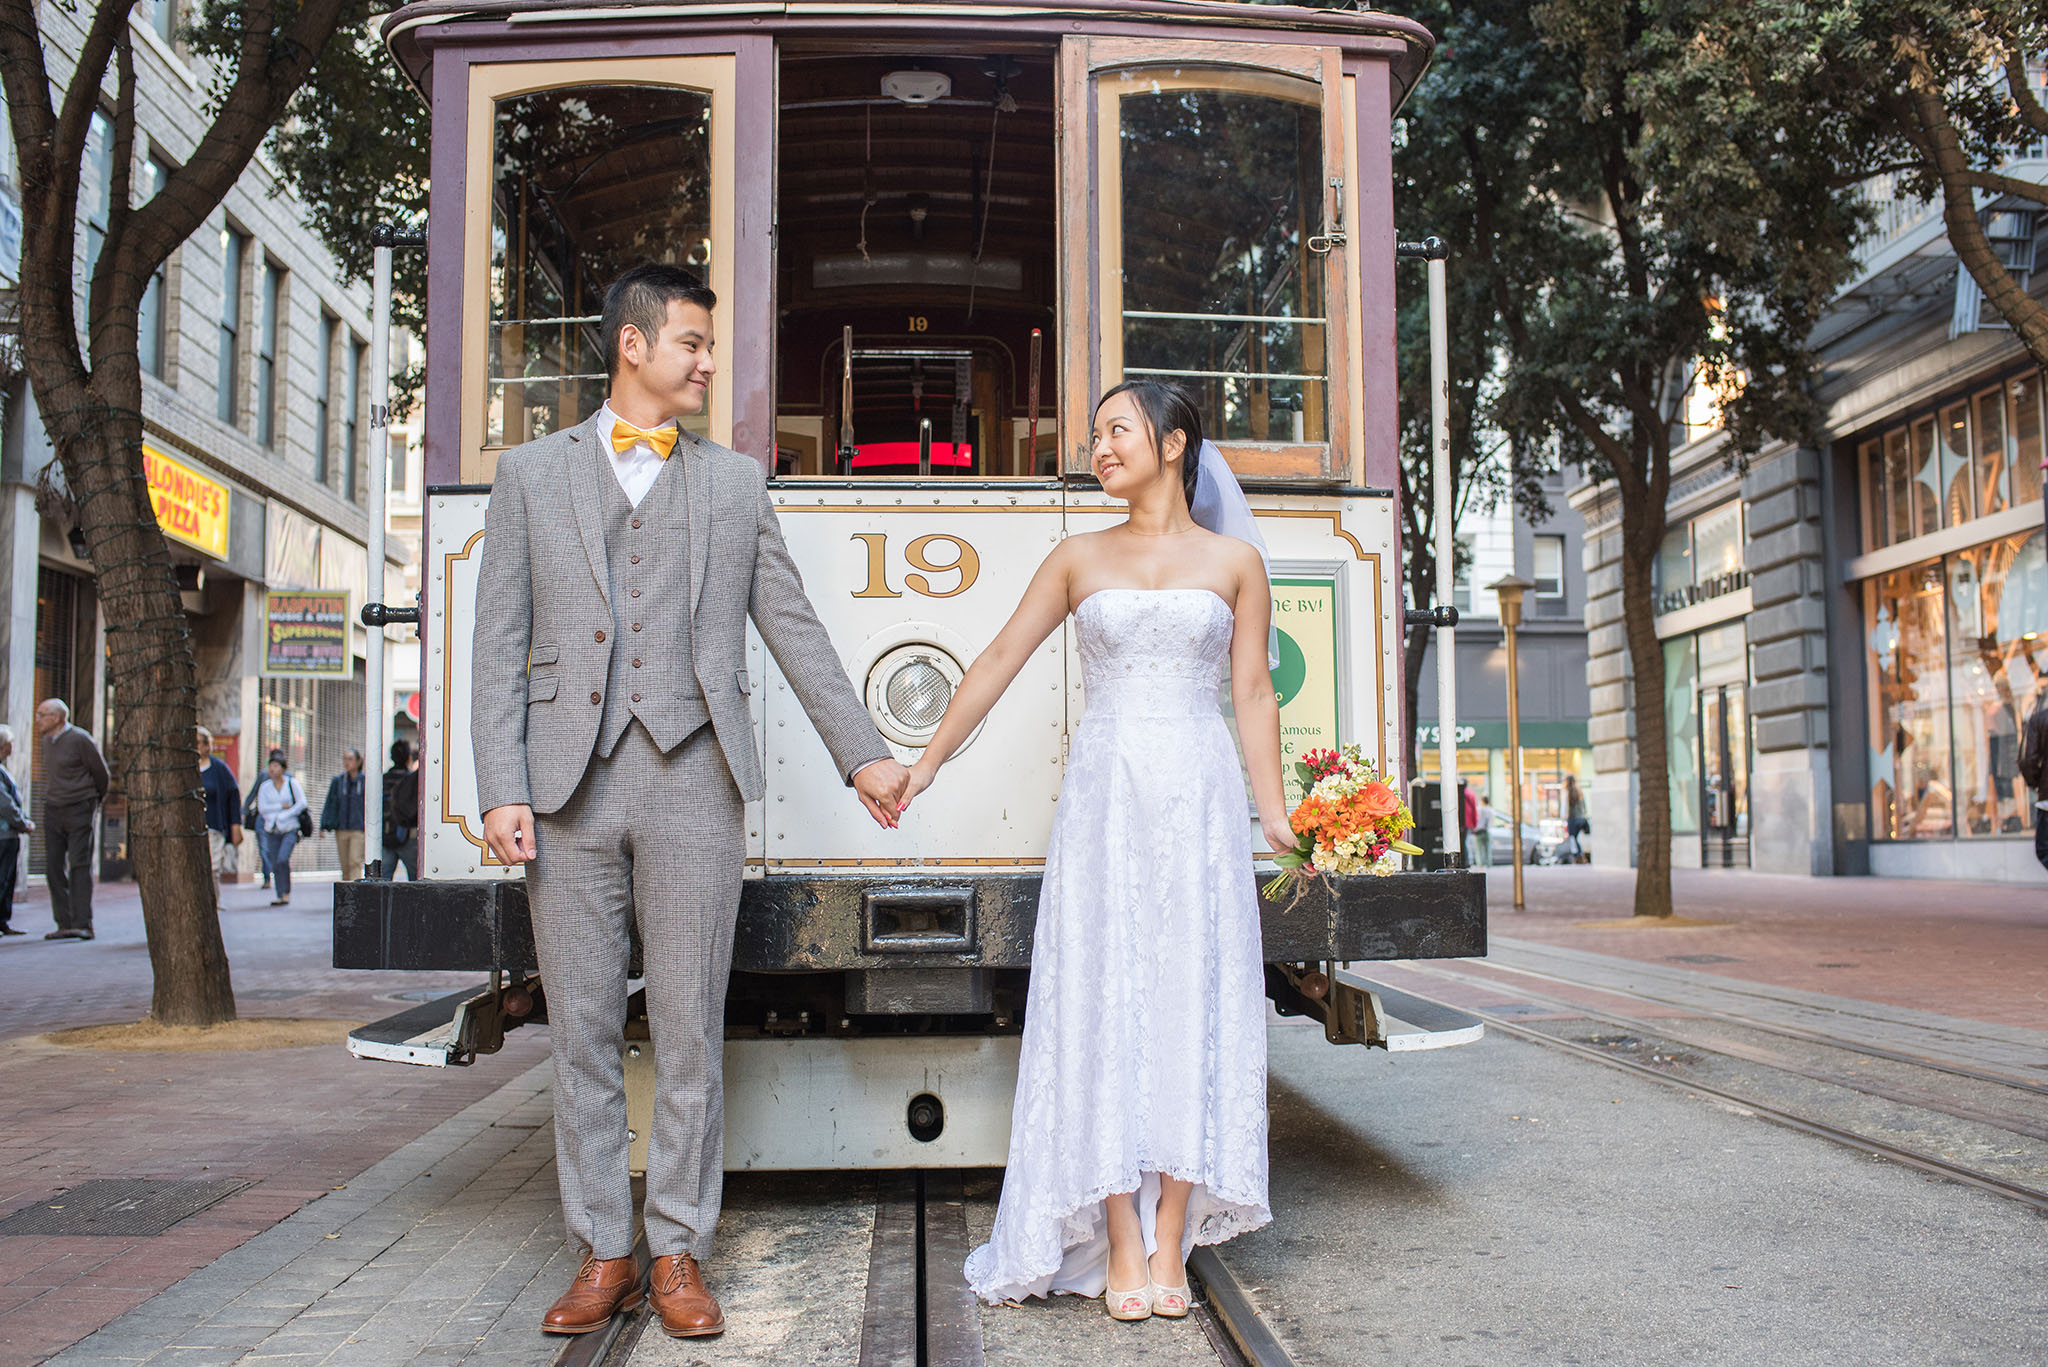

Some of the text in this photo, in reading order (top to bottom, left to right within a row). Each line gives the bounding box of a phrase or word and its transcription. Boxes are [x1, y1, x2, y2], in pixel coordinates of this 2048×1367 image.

[908, 316, 929, 332] 19
[143, 455, 220, 518] BLONDIE'S
[158, 495, 200, 537] PIZZA
[850, 533, 980, 598] 19
[269, 597, 344, 613] RASPUTIN
[272, 623, 343, 643] SUPERSTORE
[1431, 726, 1476, 743] SOP
